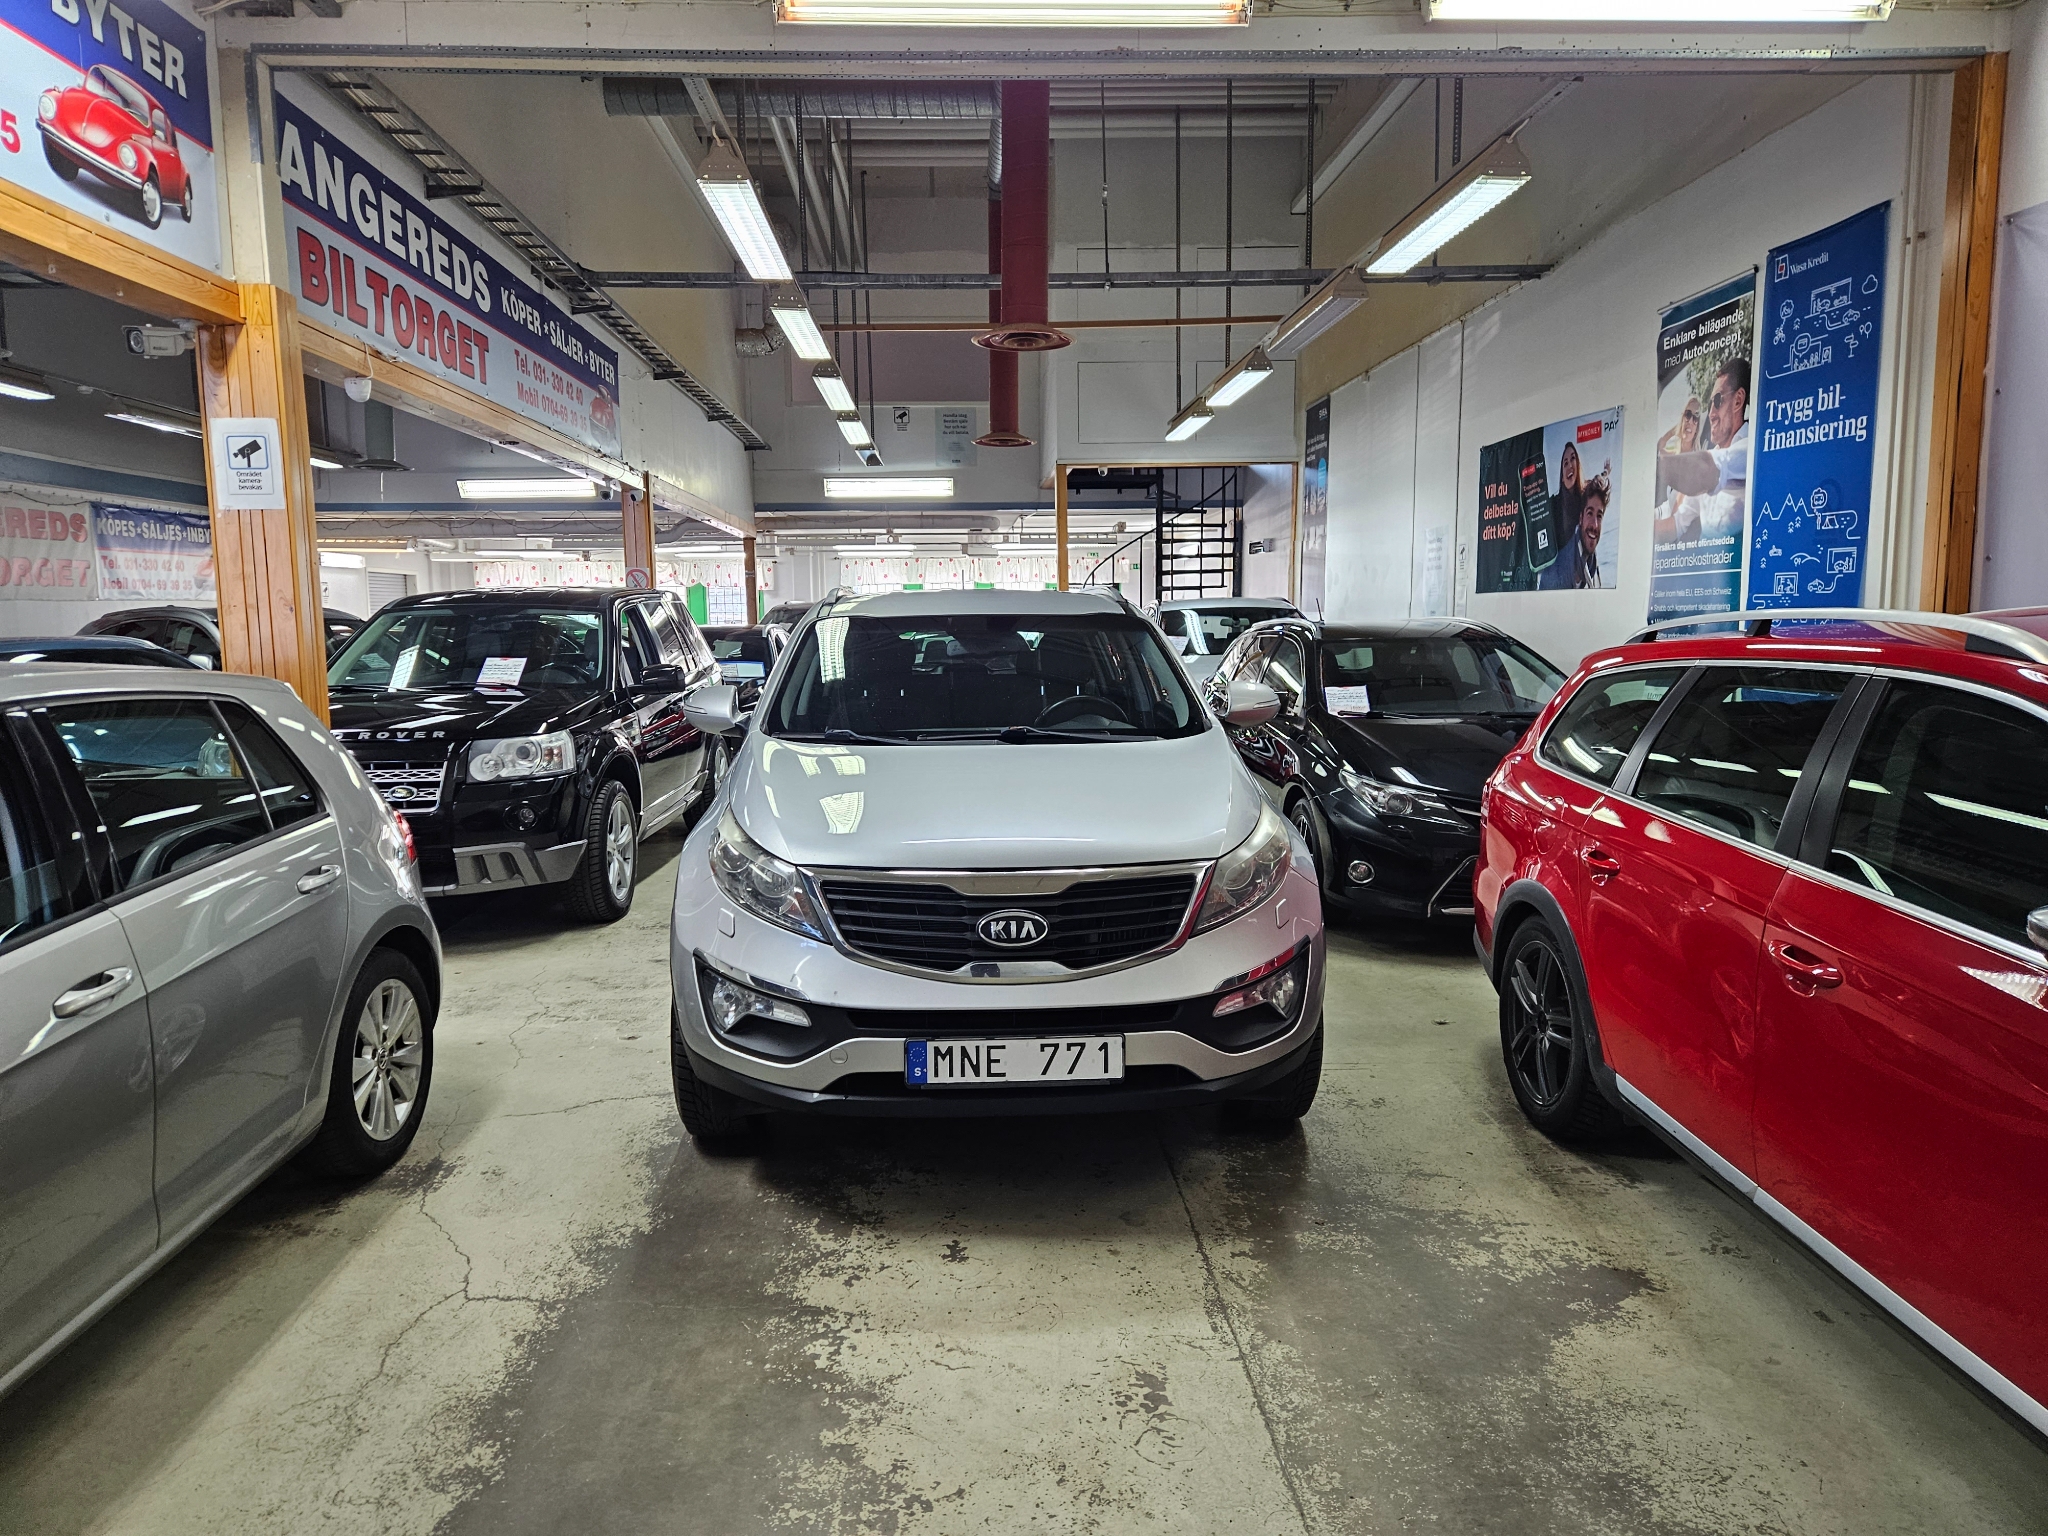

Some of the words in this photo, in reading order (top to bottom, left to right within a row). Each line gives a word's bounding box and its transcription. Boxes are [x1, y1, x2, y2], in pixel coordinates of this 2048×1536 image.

[280, 120, 491, 313] ANGEREDS
[1790, 262, 1806, 275] Wasa
[1808, 252, 1828, 269] Kredit
[297, 226, 489, 385] BILTORGET
[501, 287, 542, 336] KÖPER
[550, 321, 584, 365] SÄLJER
[589, 350, 615, 385] BYTER
[1664, 329, 1697, 350] Enklare
[1699, 309, 1744, 337] bilägande
[1665, 351, 1681, 368] med
[1682, 329, 1741, 362] AutoConcept
[514, 349, 530, 377] Tel.
[552, 371, 564, 395] 330
[566, 382, 574, 400] 42
[576, 386, 584, 406] 40
[517, 381, 539, 409] Mobil
[542, 394, 568, 423] 0704-69
[570, 411, 577, 428] 39
[1766, 396, 1814, 425] Trygg
[1818, 383, 1846, 412] bil-
[1604, 419, 1619, 432] PAY
[1763, 414, 1868, 452] finansiering
[1485, 483, 1497, 499] Vill
[1498, 482, 1508, 496] du
[1484, 500, 1518, 520] delbetala
[0, 506, 88, 542] REDS
[97, 517, 136, 538] KÖPES
[141, 521, 182, 542] SÄLJES
[1483, 526, 1496, 540] ditt
[1498, 521, 1516, 540] köp?
[1677, 541, 1685, 551] dig
[1686, 540, 1697, 549] mot
[1698, 536, 1734, 547] oförutsedda
[101, 555, 120, 570] Tel.
[161, 559, 172, 571] 42
[175, 560, 185, 572] 40
[1653, 550, 1734, 571] reparationskostnader
[103, 577, 128, 590] Mobil
[1694, 588, 1704, 597] EES
[1713, 587, 1732, 596] Schweiz
[1675, 604, 1697, 612] kompetent
[358, 731, 445, 740] ROVER
[990, 920, 1037, 939] KIA
[933, 1045, 1006, 1078] MNE
[1039, 1042, 1109, 1076] 771
[914, 1068, 921, 1076] S
